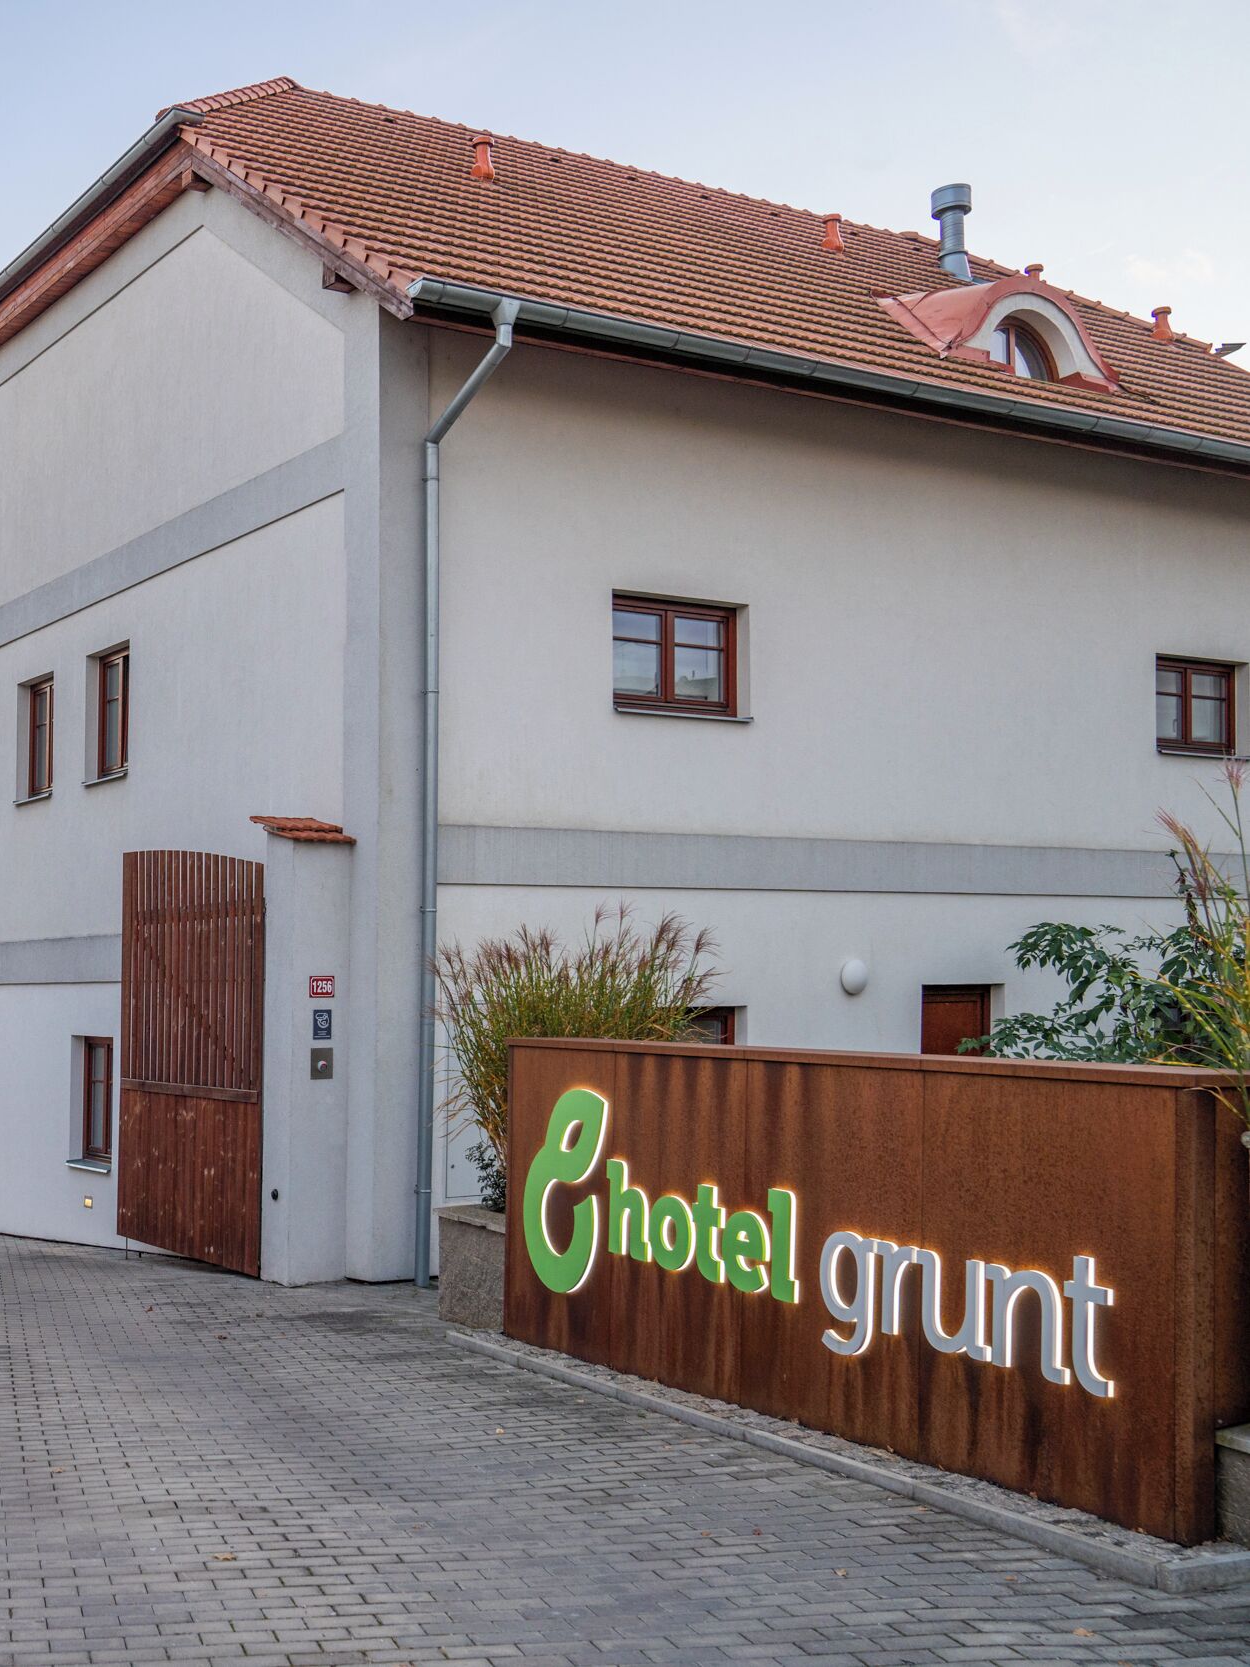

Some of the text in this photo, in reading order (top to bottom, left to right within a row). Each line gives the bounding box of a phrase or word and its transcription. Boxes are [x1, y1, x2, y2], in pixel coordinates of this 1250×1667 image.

[312, 980, 332, 993] 1256
[606, 1158, 1114, 1398] hotel grunt
